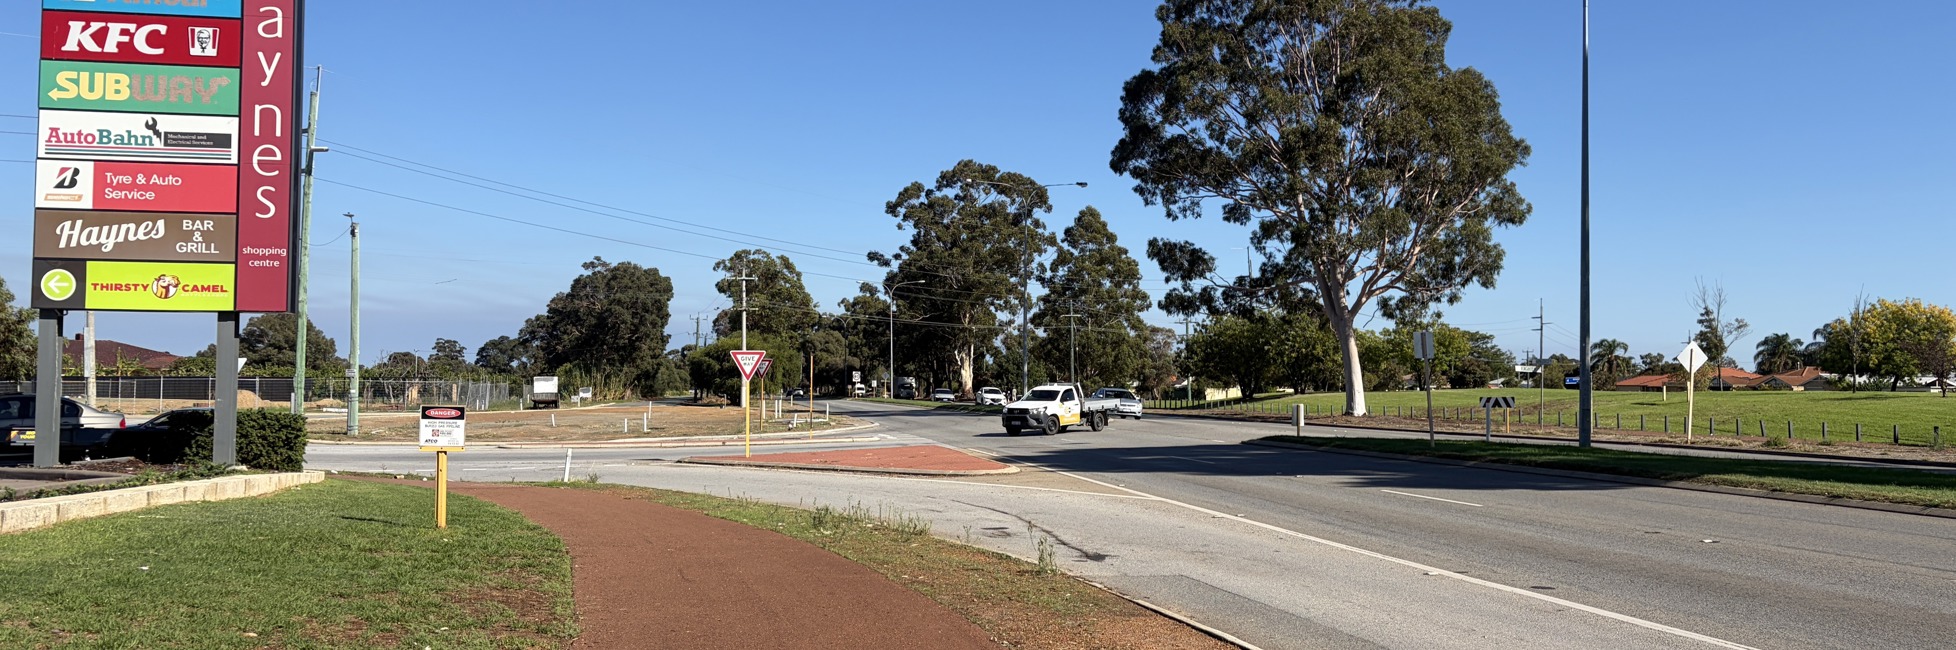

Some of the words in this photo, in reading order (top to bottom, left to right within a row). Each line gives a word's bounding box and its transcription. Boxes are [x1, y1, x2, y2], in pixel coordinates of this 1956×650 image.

[61, 21, 167, 55] KFC
[47, 70, 231, 104] SUBWAY
[45, 127, 154, 146] AutoBahn
[104, 172, 132, 187] Tyre
[136, 173, 146, 185] &
[149, 174, 182, 186] Auto
[104, 188, 155, 200] Service
[182, 219, 214, 231] BAR
[55, 218, 165, 252] Haynes
[192, 231, 203, 242] &
[175, 242, 220, 254] GRILL
[242, 246, 287, 257] shopping
[248, 259, 280, 267] centre
[91, 282, 150, 292] THIRSTY
[181, 284, 228, 293] CAMEL
